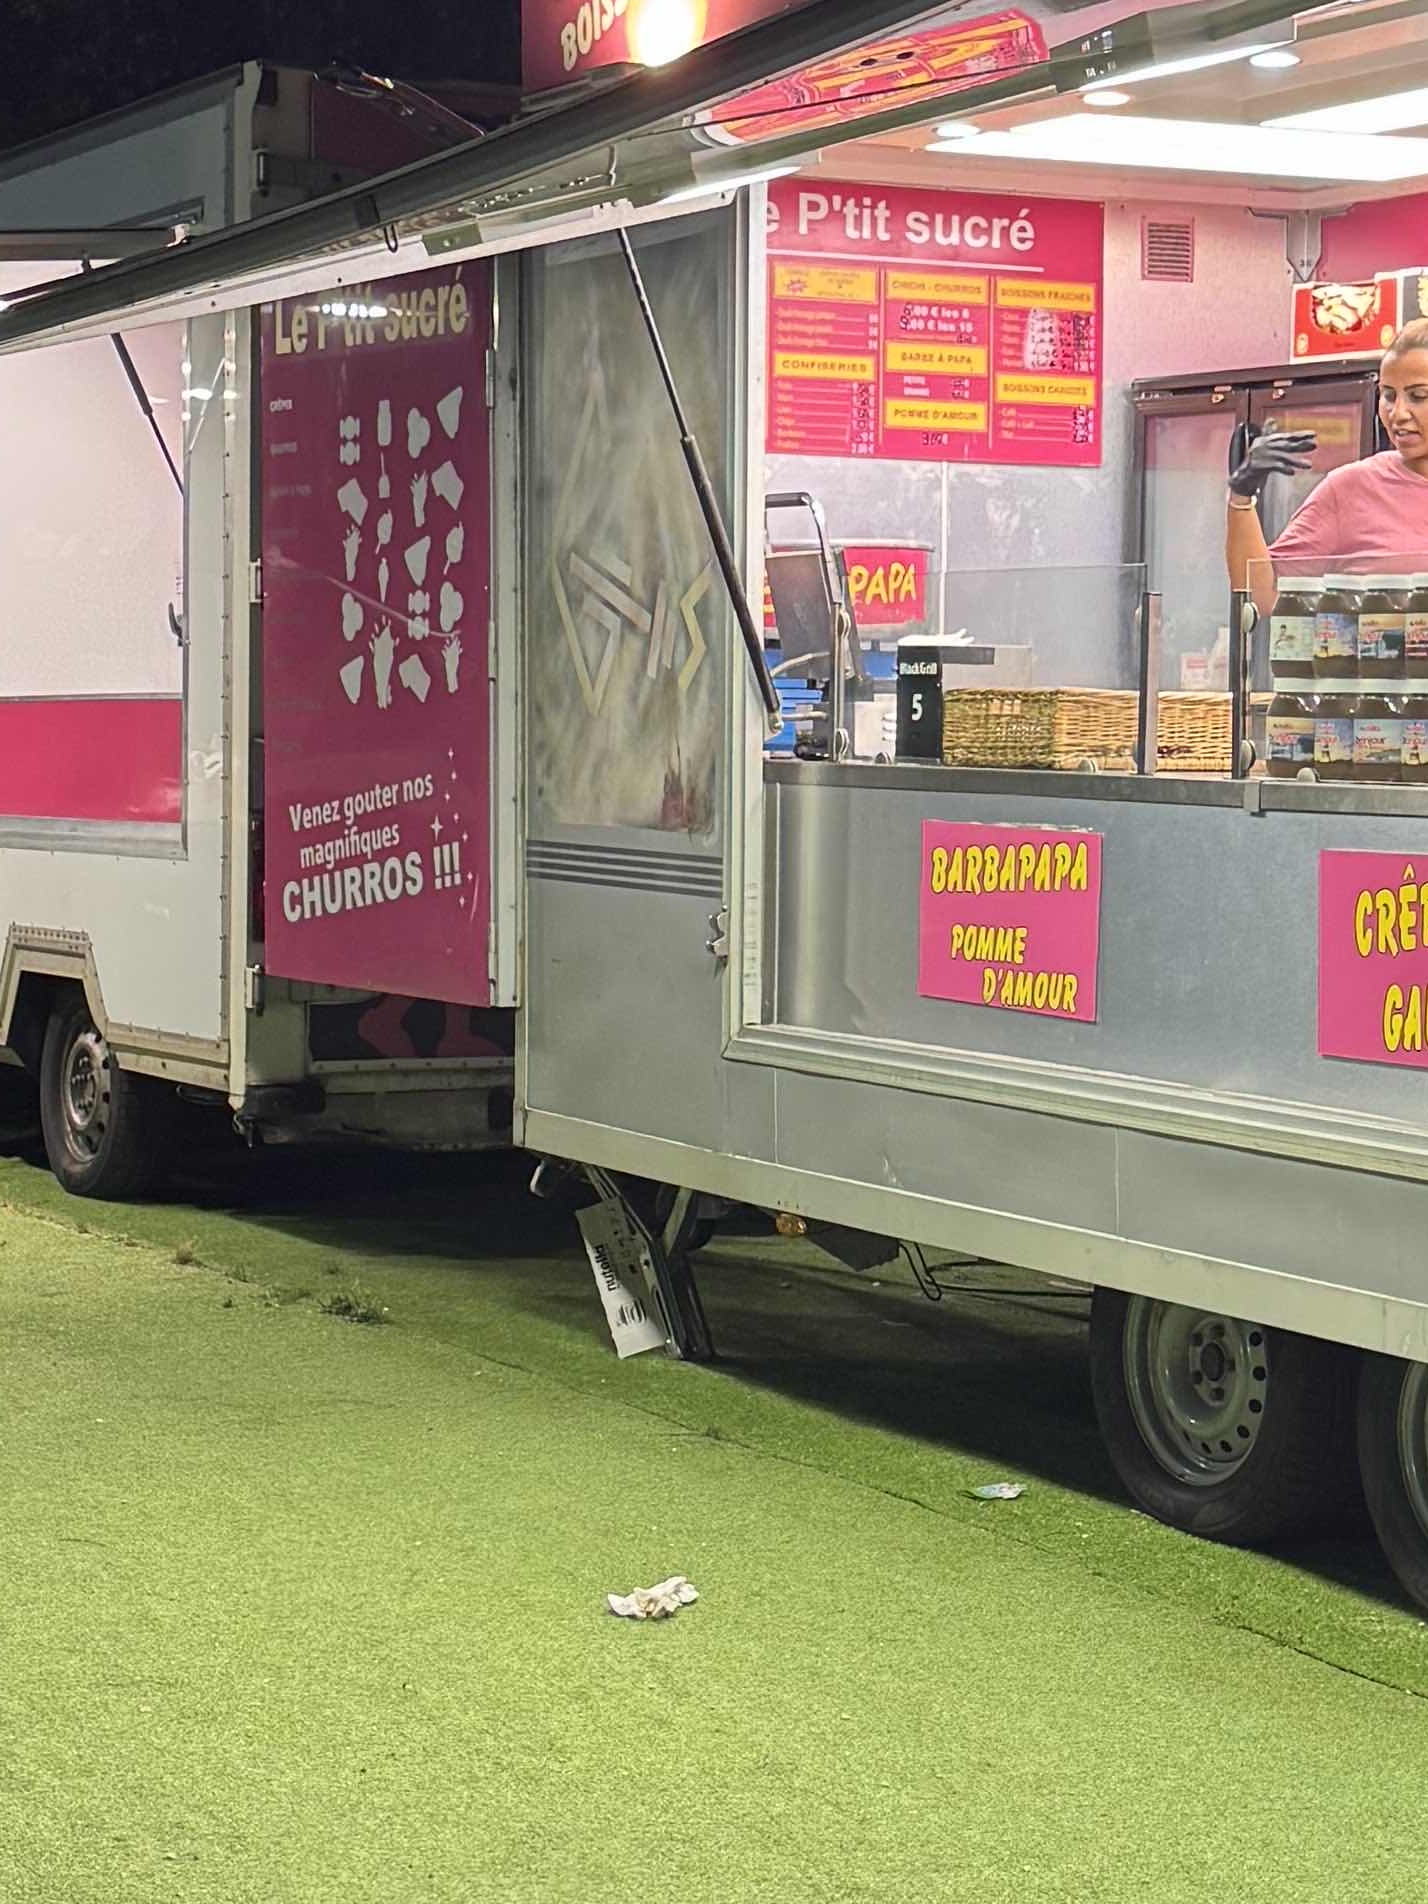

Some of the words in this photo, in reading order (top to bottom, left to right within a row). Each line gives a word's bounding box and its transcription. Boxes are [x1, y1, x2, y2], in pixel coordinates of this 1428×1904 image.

[798, 192, 892, 241] P'tit
[905, 210, 1036, 252] sucré
[275, 301, 308, 354] Le
[384, 266, 467, 342] sucré
[849, 561, 917, 607] PAPA
[911, 693, 923, 721] 5
[289, 800, 341, 832] Venez
[343, 783, 399, 825] gouter
[403, 773, 434, 802] nos
[300, 823, 400, 870] magnifiques
[931, 842, 1088, 895] BARBAPAPA
[282, 851, 423, 923] CHURROS
[433, 841, 462, 890] !!!
[951, 924, 1028, 964] POMME
[983, 967, 1079, 1013] D'AMOUR
